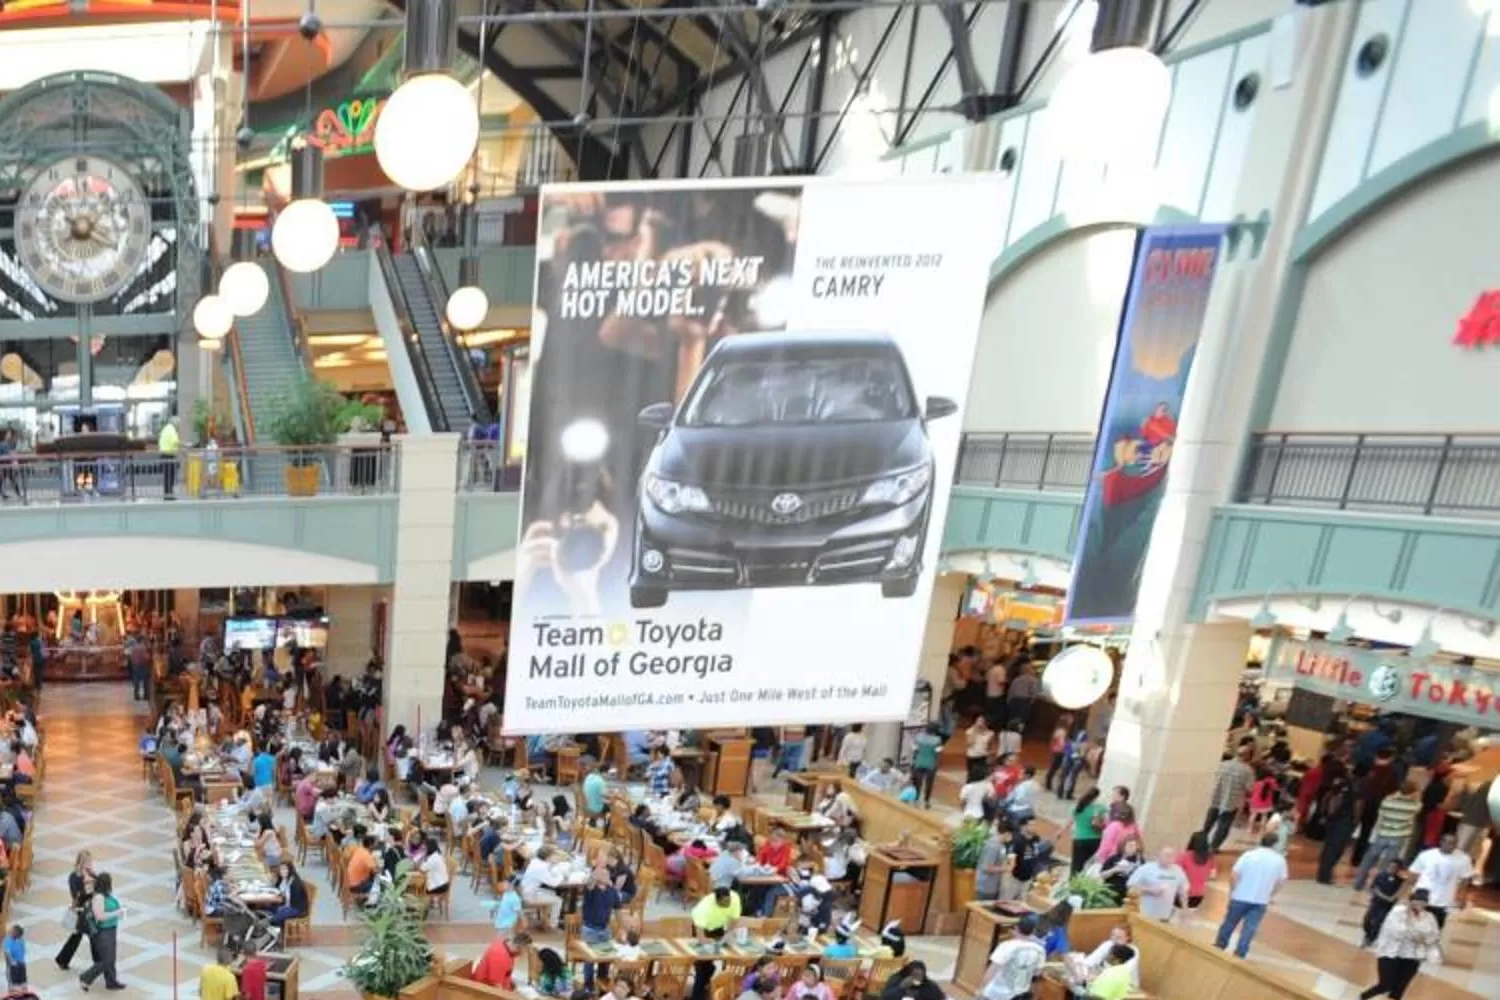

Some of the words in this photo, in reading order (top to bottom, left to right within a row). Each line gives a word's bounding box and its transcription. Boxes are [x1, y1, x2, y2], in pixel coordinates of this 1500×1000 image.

[563, 258, 692, 290] AMERICA'S
[699, 256, 764, 287] NEXT
[815, 256, 837, 270] THE
[840, 254, 912, 269] REINVENTED
[915, 252, 944, 269] 2012
[811, 273, 885, 300] CAMRY
[561, 290, 609, 319] HOT
[615, 287, 706, 318] MODEL.
[533, 622, 604, 648] Team
[636, 616, 723, 649] Toyota
[529, 654, 586, 680] Mall
[593, 651, 621, 677] of
[629, 651, 734, 679] Georgia
[1296, 646, 1365, 689] Little
[696, 689, 726, 704] Just
[729, 687, 754, 702] One
[757, 686, 782, 701] Mile
[787, 685, 817, 700] West
[820, 684, 834, 700] of
[837, 684, 858, 699] the
[860, 682, 888, 698] Mall
